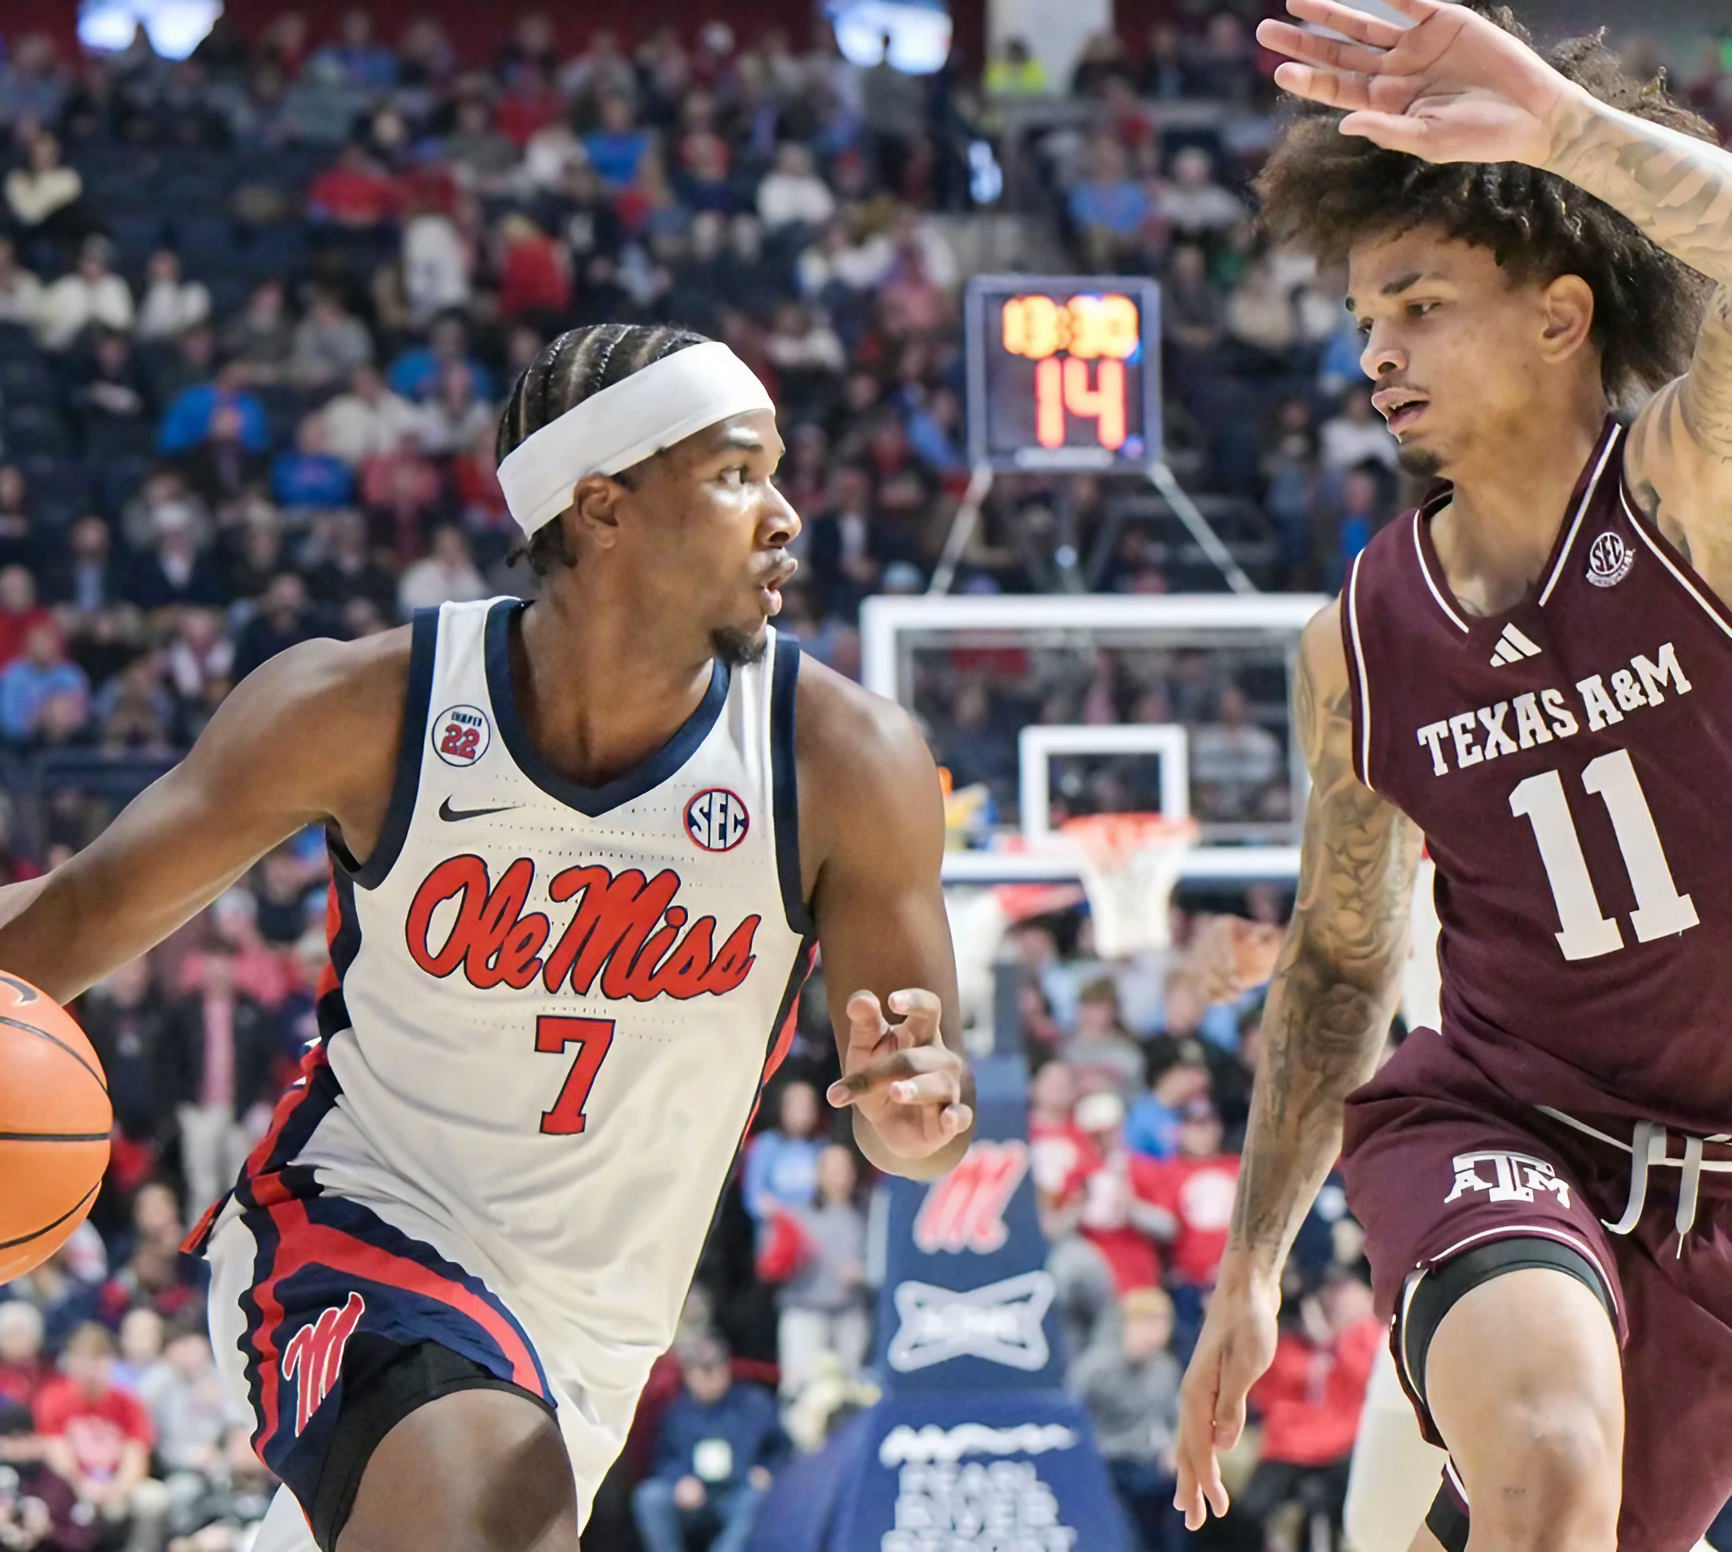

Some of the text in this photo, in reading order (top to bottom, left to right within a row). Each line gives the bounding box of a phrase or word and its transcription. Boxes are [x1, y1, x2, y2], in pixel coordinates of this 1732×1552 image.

[1035, 356, 1127, 450] 14
[1592, 534, 1622, 573] SEC
[440, 722, 480, 761] 22
[1416, 641, 1693, 777] TEXAS A&M
[688, 791, 749, 850] SEC
[1508, 748, 1700, 961] 11
[405, 853, 762, 1002] Ole Miss
[534, 1014, 616, 1136] 7
